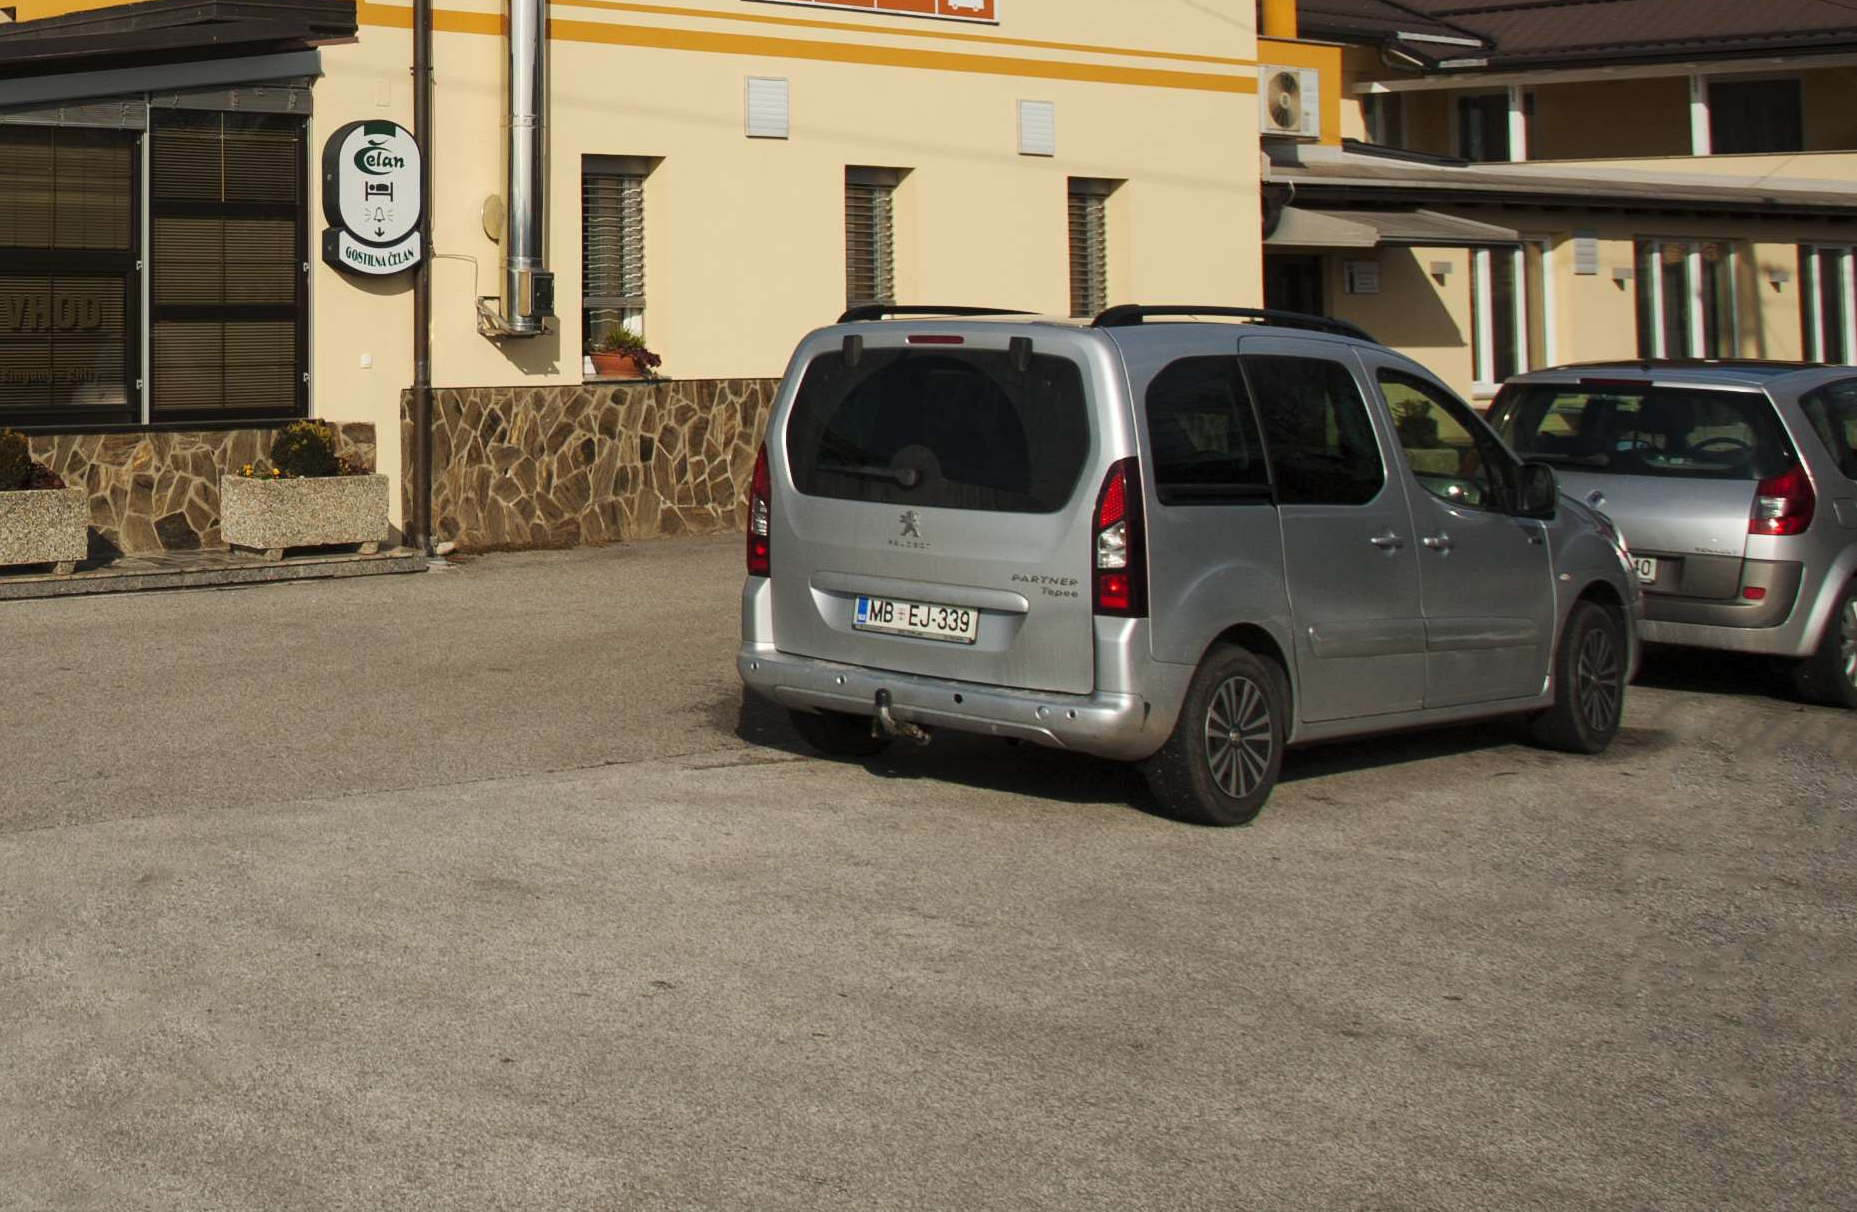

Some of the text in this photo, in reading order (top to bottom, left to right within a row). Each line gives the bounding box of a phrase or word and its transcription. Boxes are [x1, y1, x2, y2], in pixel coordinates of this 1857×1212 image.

[353, 139, 405, 176] Čelan
[345, 245, 415, 267] GOSTILNA ČELAN
[4, 295, 101, 329] VHOD
[1011, 573, 1078, 587] PARTNER
[869, 599, 970, 633] MB EJ-339
